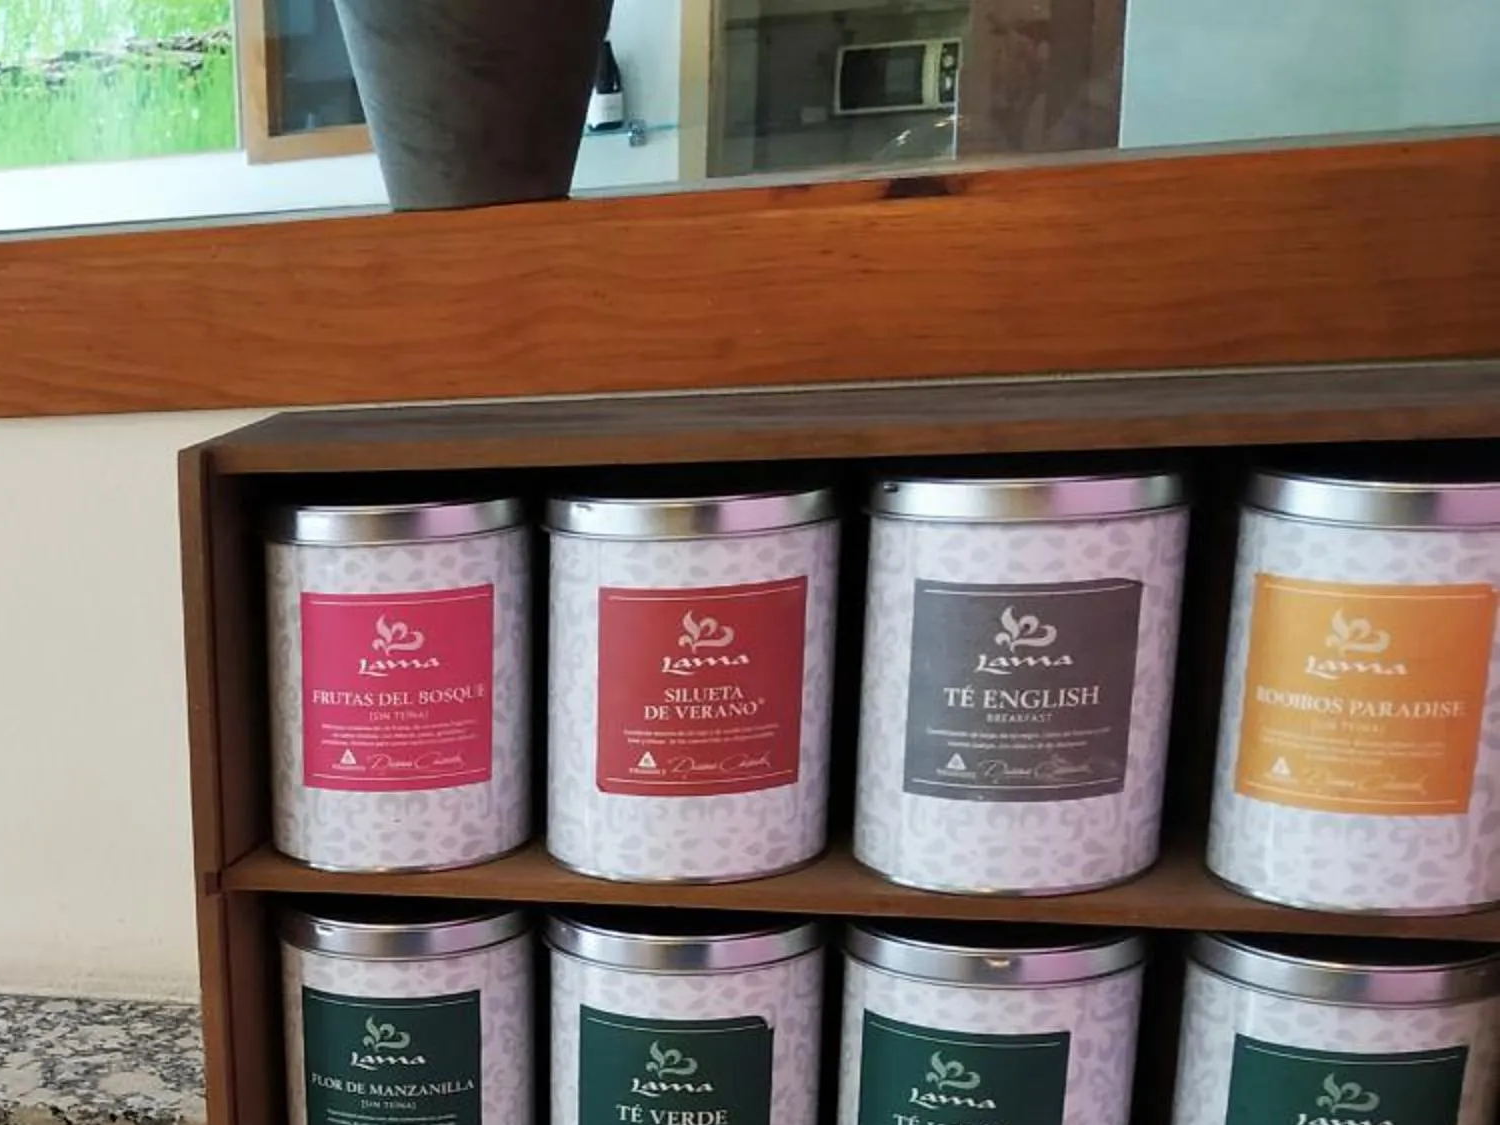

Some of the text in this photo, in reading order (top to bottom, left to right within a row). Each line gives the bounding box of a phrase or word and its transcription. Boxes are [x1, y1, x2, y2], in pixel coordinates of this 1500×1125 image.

[973, 654, 1075, 675] Lama
[312, 685, 485, 706] FRUTAS DEL BOSQUE
[664, 686, 744, 703] SILUETA
[943, 685, 1100, 709] TÉ ENGLISH
[644, 705, 669, 720] DE
[986, 713, 1053, 723] BREAKFAST
[1349, 699, 1468, 719] PARADISE
[350, 1051, 427, 1071] Lama
[311, 1072, 475, 1098] FLOR DE MANZANILLA
[630, 1078, 715, 1098] Lama
[908, 1087, 997, 1110] Lama
[615, 1104, 644, 1124] TÉ
